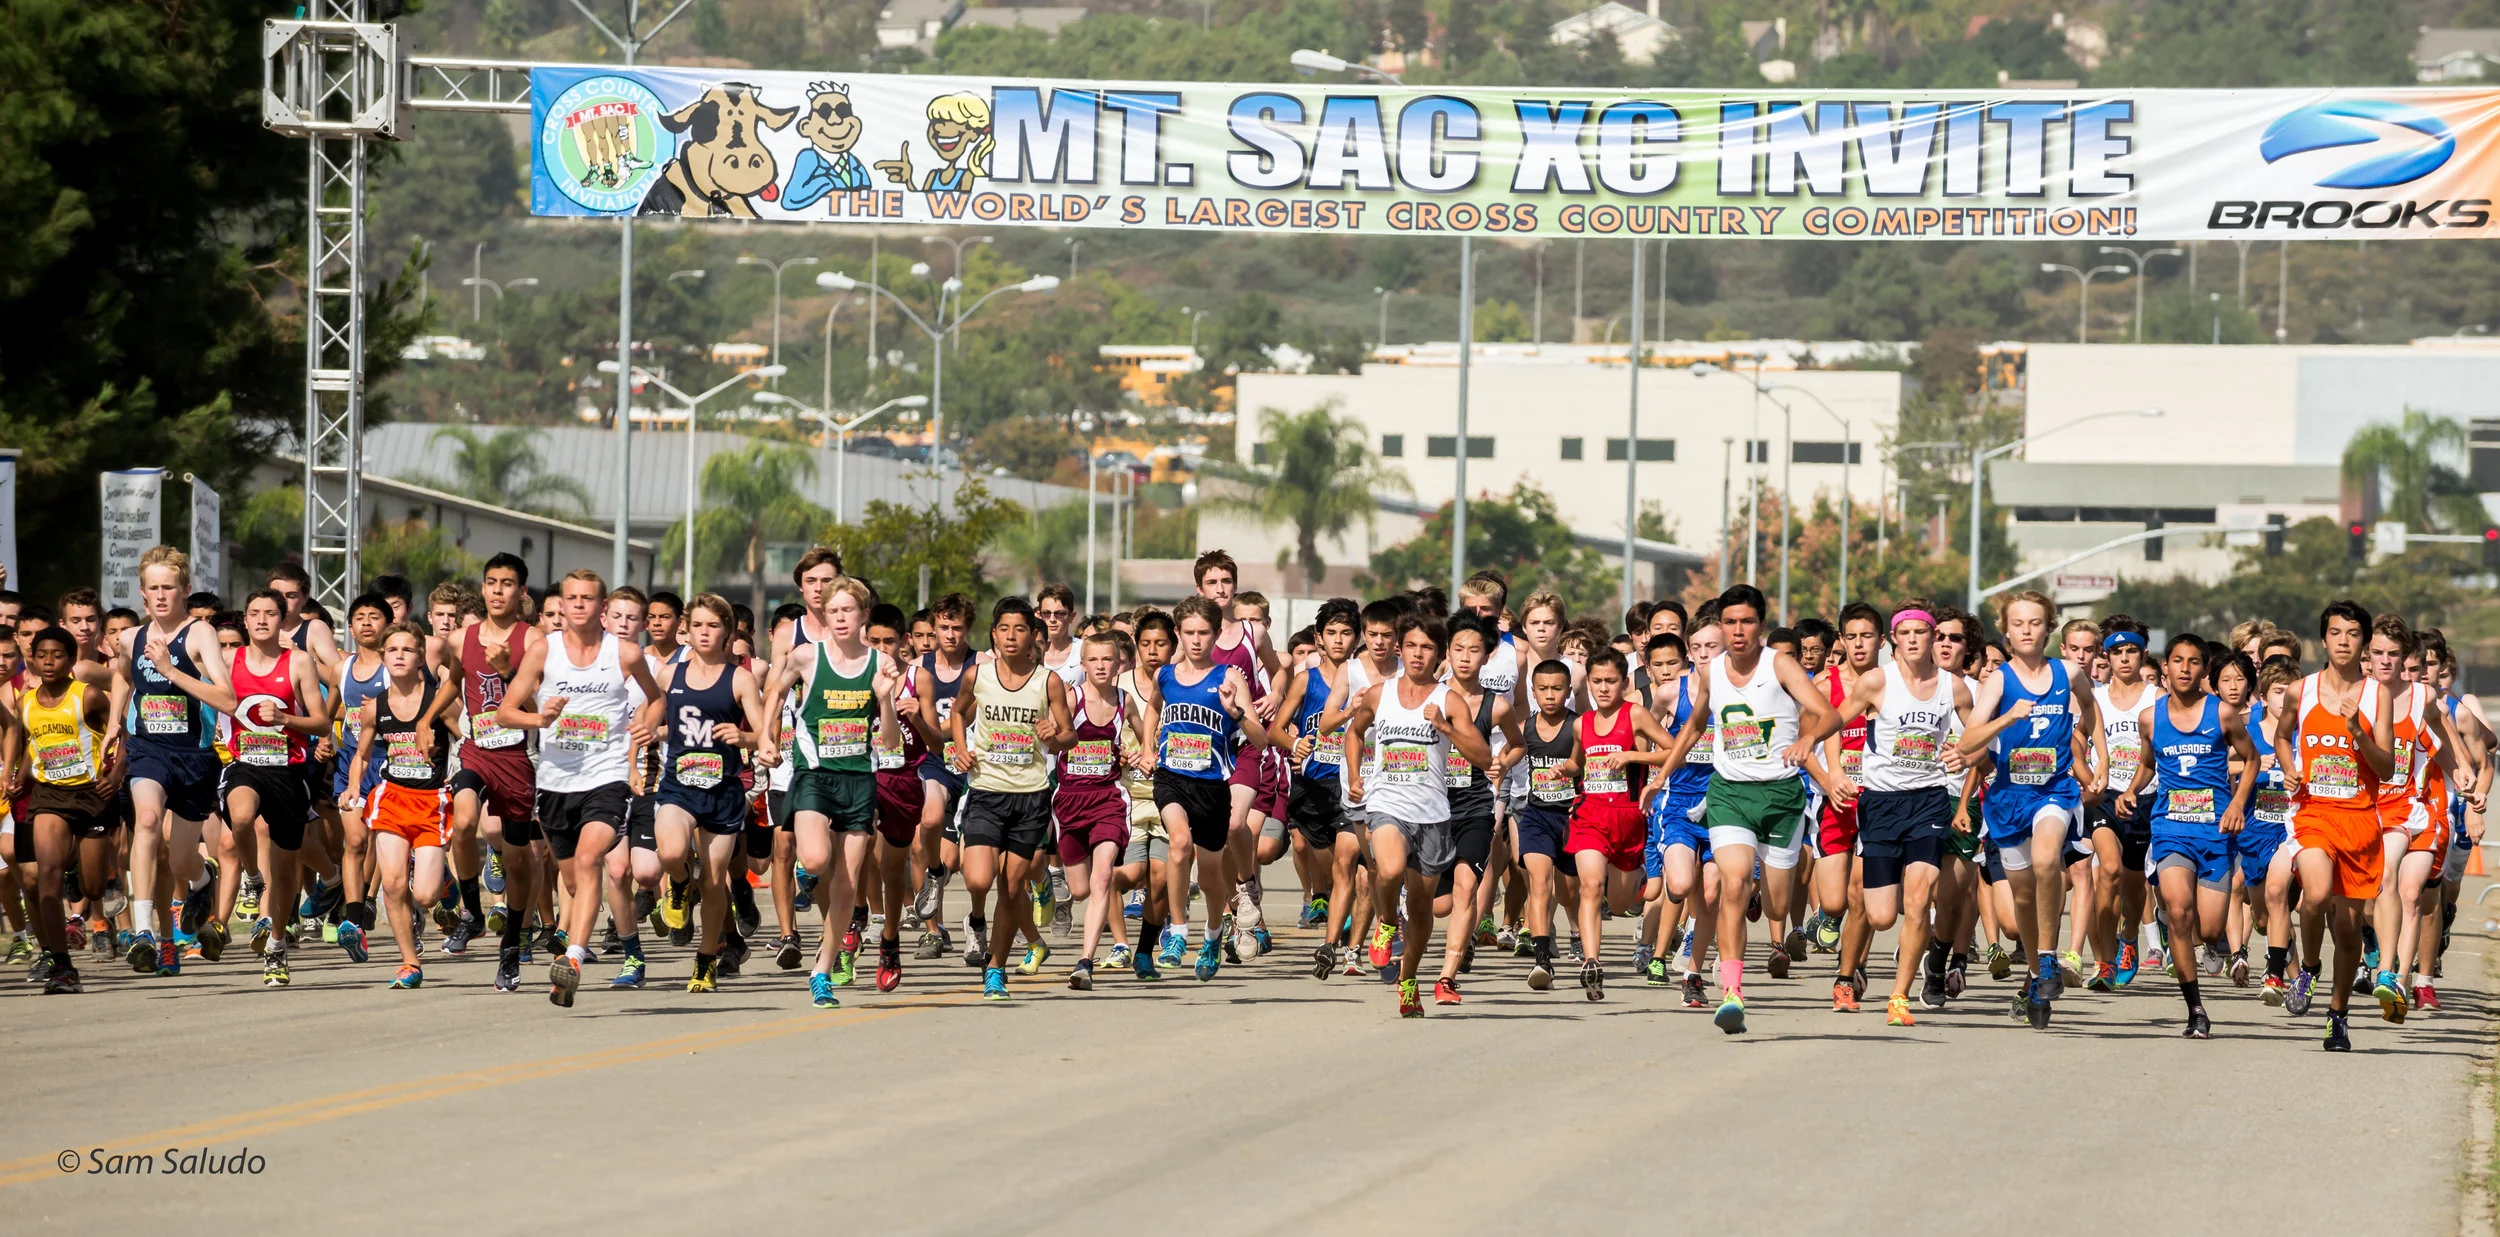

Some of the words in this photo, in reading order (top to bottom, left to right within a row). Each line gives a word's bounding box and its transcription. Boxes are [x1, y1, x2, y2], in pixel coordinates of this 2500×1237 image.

[543, 87, 582, 145] CROSS
[599, 103, 626, 117] SAC
[989, 85, 1195, 188] MT.
[1226, 90, 1483, 192] SAC
[1510, 98, 1684, 197] XC
[1717, 98, 2135, 199] INVITE
[827, 190, 903, 218] THE
[1165, 196, 1366, 230] LARGEST
[1387, 201, 1537, 234] CROSS
[1559, 204, 1786, 236] COUNTRY
[1802, 206, 2138, 237] COMPETITION!
[2207, 199, 2492, 230] BROOKS
[556, 681, 610, 695] Foothill
[823, 689, 872, 701] PATRICK
[234, 693, 289, 733] C
[984, 704, 1039, 725] SANTEE
[1162, 702, 1223, 735] URBANK
[678, 704, 715, 748] SM
[1898, 711, 1943, 730] VISTA
[42, 723, 74, 735] CAMINO
[146, 723, 173, 732] 0793
[2029, 716, 2051, 739] P
[559, 741, 590, 751] 12901
[824, 745, 853, 756] 19375
[2162, 743, 2212, 757] PALISADES
[247, 756, 270, 765] 9464
[990, 753, 1019, 763] 22394
[1171, 758, 1194, 769] 8086
[1531, 756, 1544, 767] SAN
[1894, 758, 1923, 769] 25897
[1071, 765, 1099, 774] 19052
[2177, 755, 2198, 776] P
[1387, 773, 1411, 782] 8612
[2014, 774, 2042, 783] 18912
[1586, 782, 1613, 791] 26970
[2313, 785, 2342, 796] 19861
